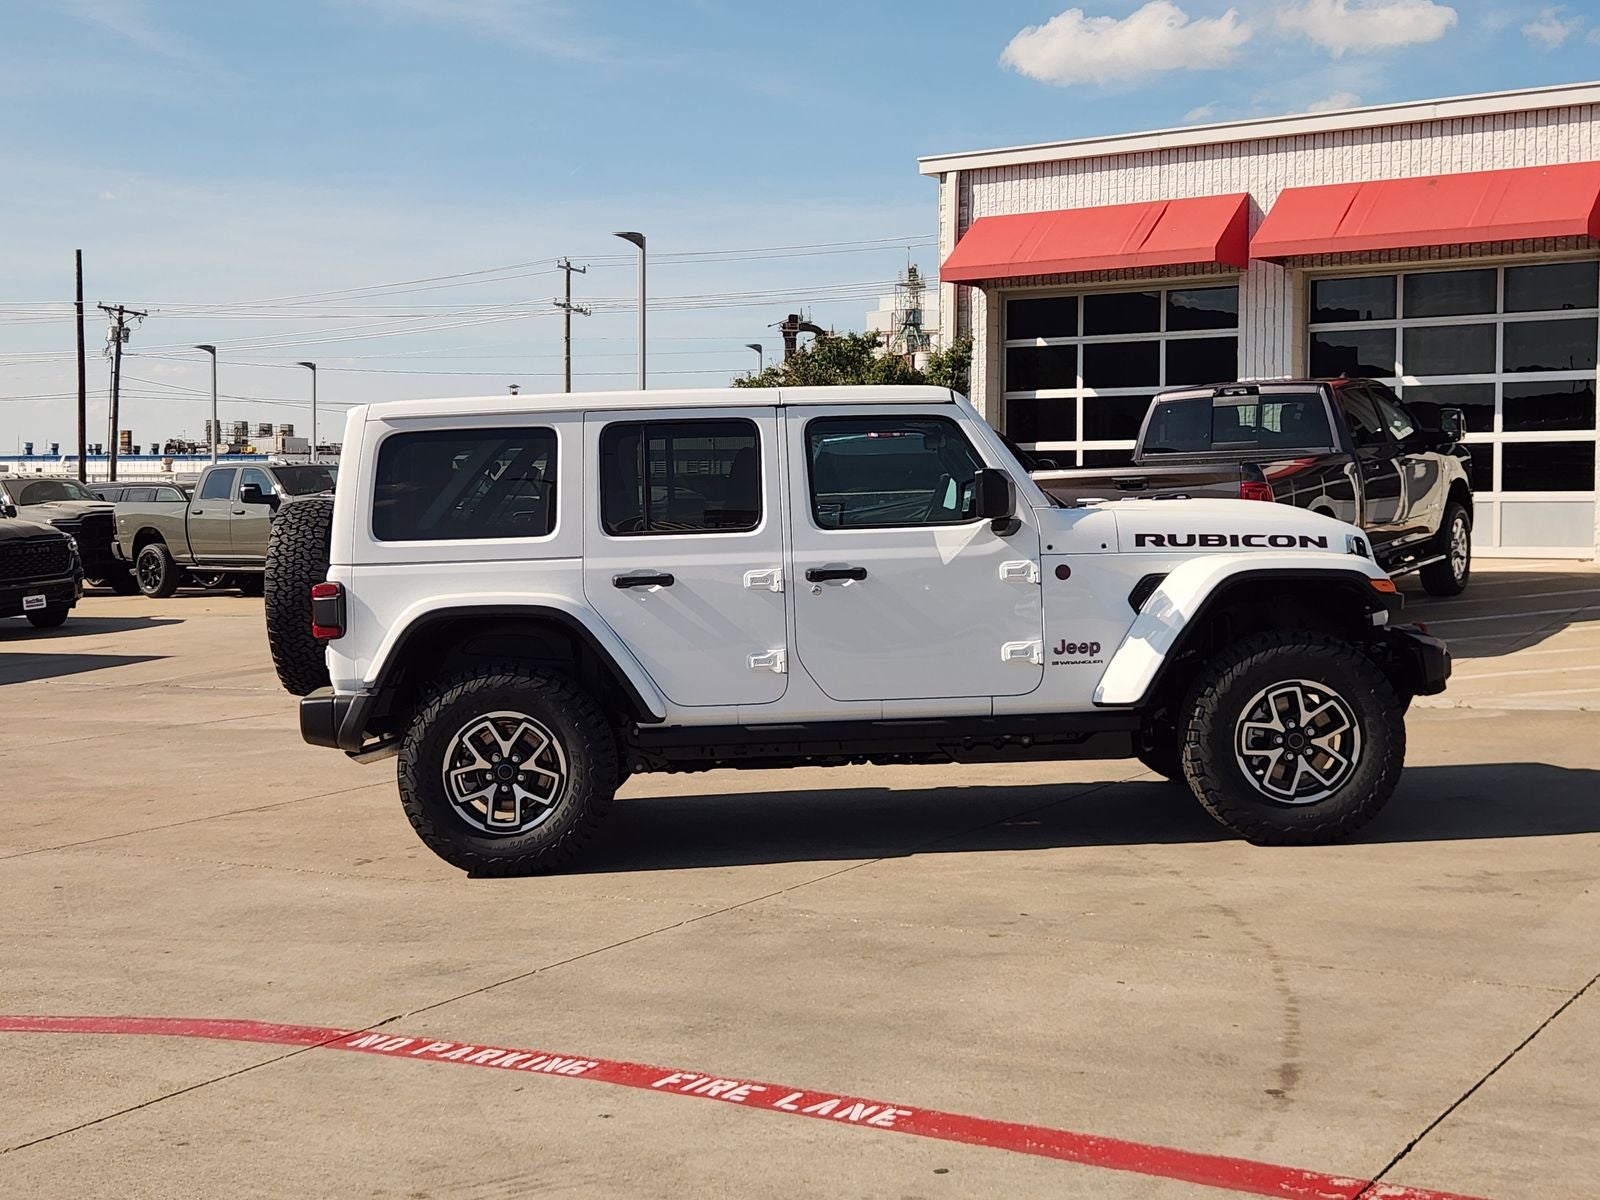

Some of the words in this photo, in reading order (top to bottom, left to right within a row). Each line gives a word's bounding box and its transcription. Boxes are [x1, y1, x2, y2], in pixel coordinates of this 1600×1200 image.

[1135, 533, 1328, 548] RUBICON
[1053, 639, 1101, 656] Jeep
[346, 1033, 415, 1051] NO
[411, 1041, 599, 1076] PARKING
[651, 1072, 768, 1102] FIRE
[772, 1092, 913, 1127] LANE
